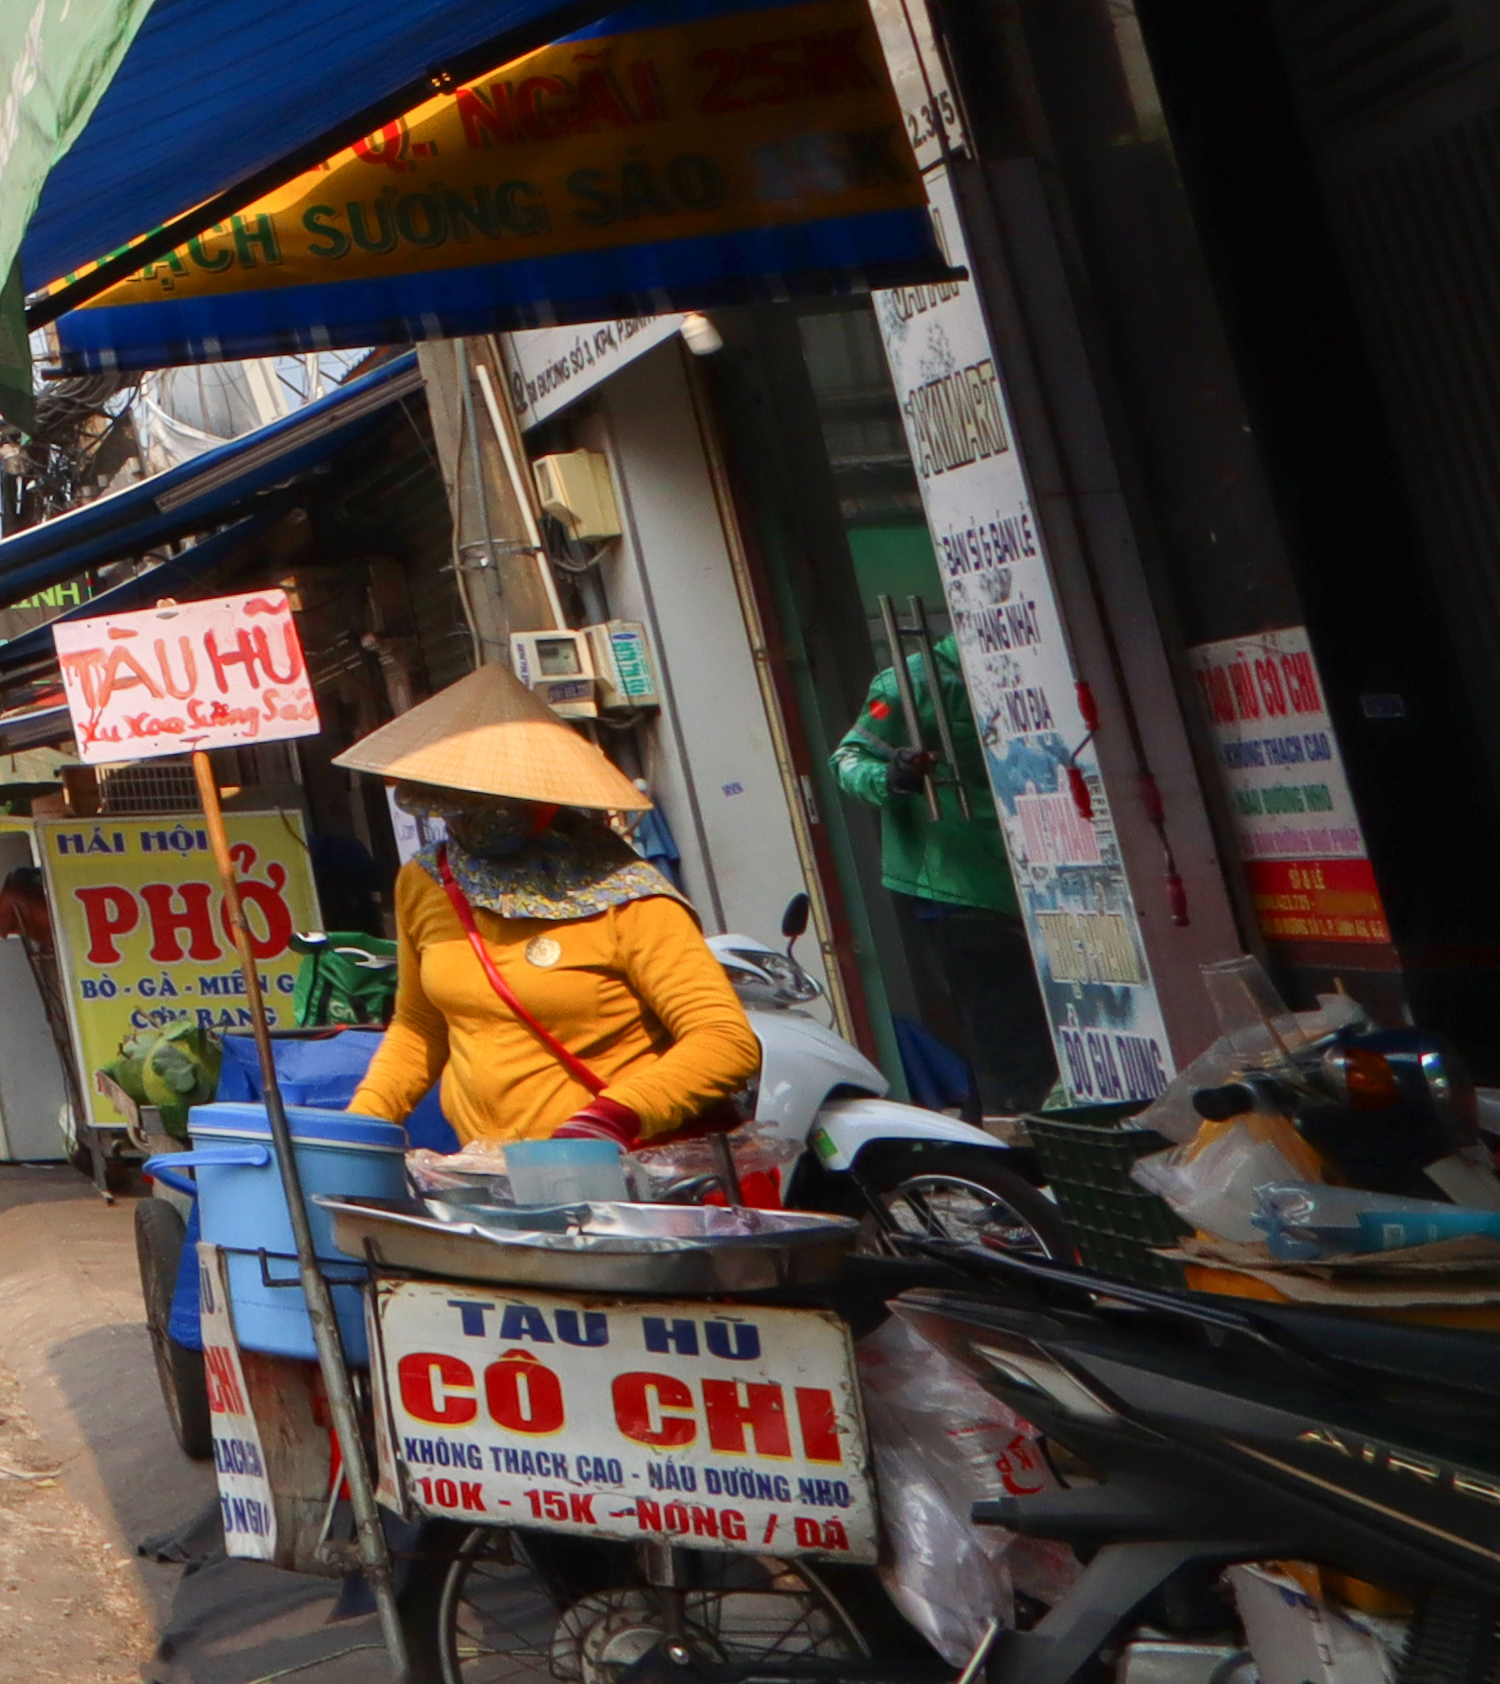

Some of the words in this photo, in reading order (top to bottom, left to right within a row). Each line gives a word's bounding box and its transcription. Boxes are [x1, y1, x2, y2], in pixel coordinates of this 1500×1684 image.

[304, 178, 550, 261] SƯƠNG
[564, 142, 728, 227] SÁO
[60, 627, 197, 708] TÀU
[204, 597, 303, 694] HŨ
[140, 824, 208, 858] HỘI
[74, 843, 293, 965] PHỞ
[81, 972, 117, 999] BÒ
[137, 971, 179, 998] GÀ
[397, 1348, 567, 1436] CÔ
[611, 1370, 844, 1467] CHI
[404, 1435, 485, 1473] KHÔNG
[489, 1445, 571, 1482] THẠCH
[575, 1456, 623, 1484] CAO
[704, 1463, 792, 1505] ĐƯỜNG
[420, 1477, 487, 1513] 10K
[524, 1488, 599, 1525] 15K
[635, 1496, 748, 1542] NÓNG
[794, 1515, 850, 1552] ĐÁ
